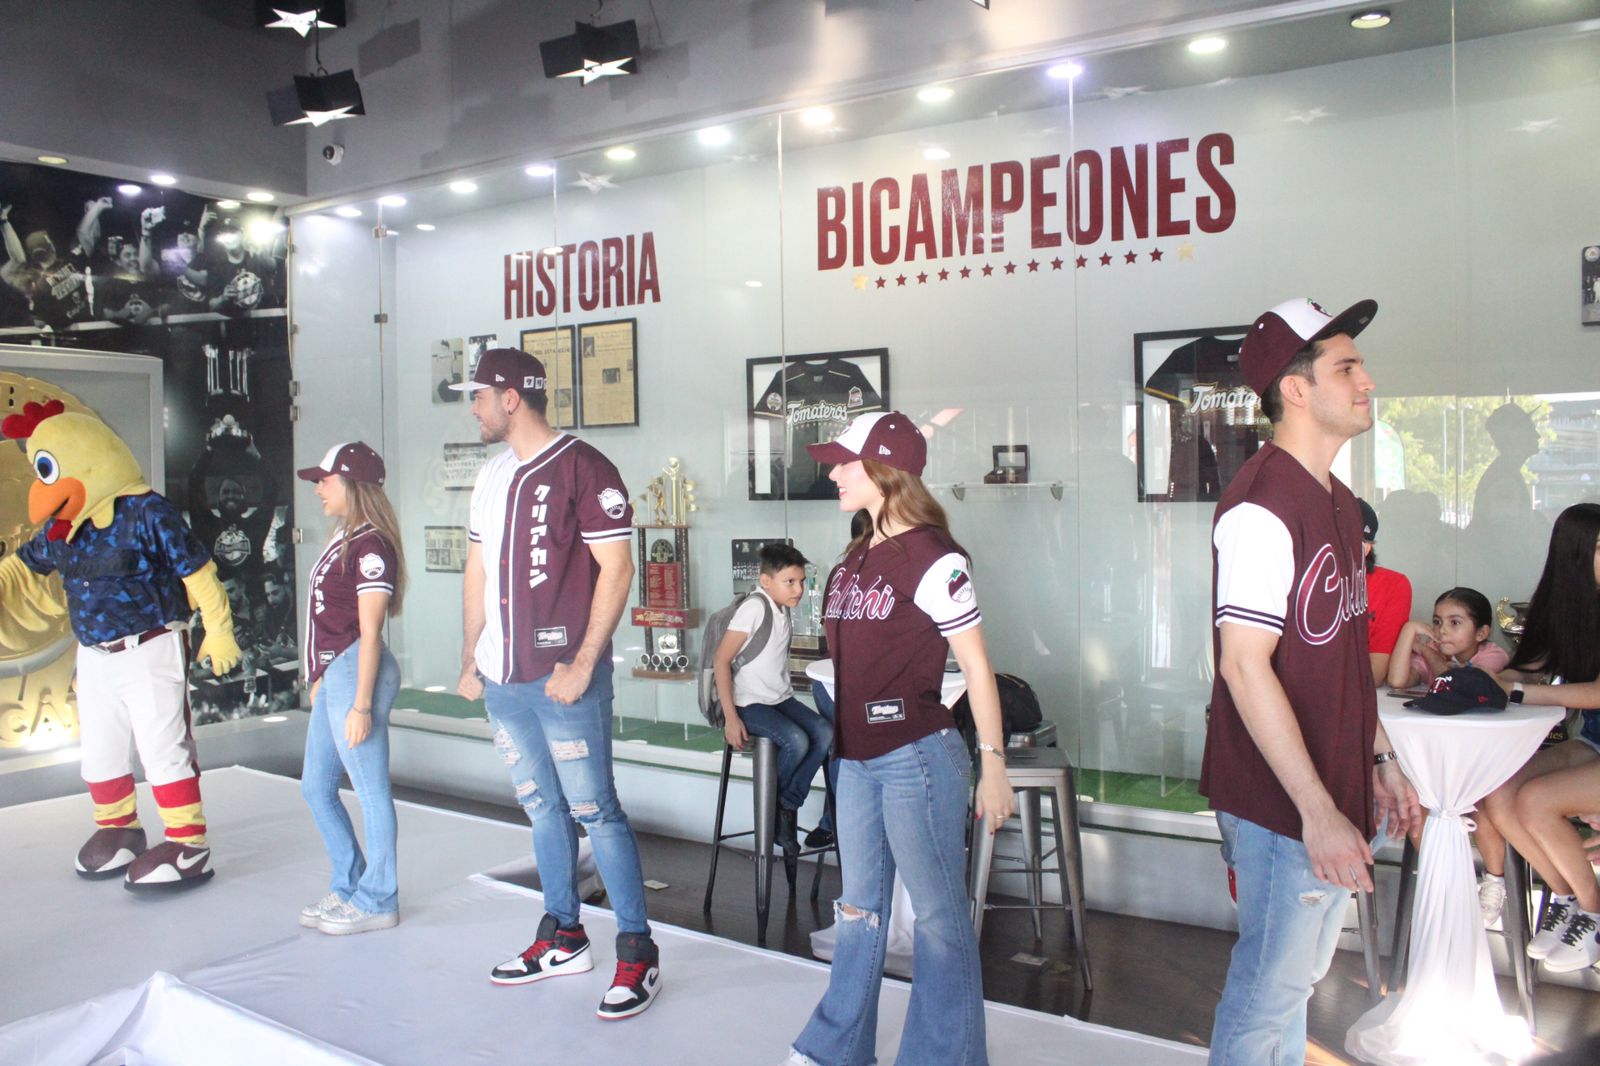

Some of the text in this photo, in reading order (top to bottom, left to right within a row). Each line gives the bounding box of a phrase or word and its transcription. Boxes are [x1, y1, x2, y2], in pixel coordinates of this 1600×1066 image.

[817, 132, 1236, 270] BICAMPEONES
[504, 232, 661, 320] HISTORIA
[787, 400, 848, 425] Tomateros
[529, 484, 551, 589] クリアカン
